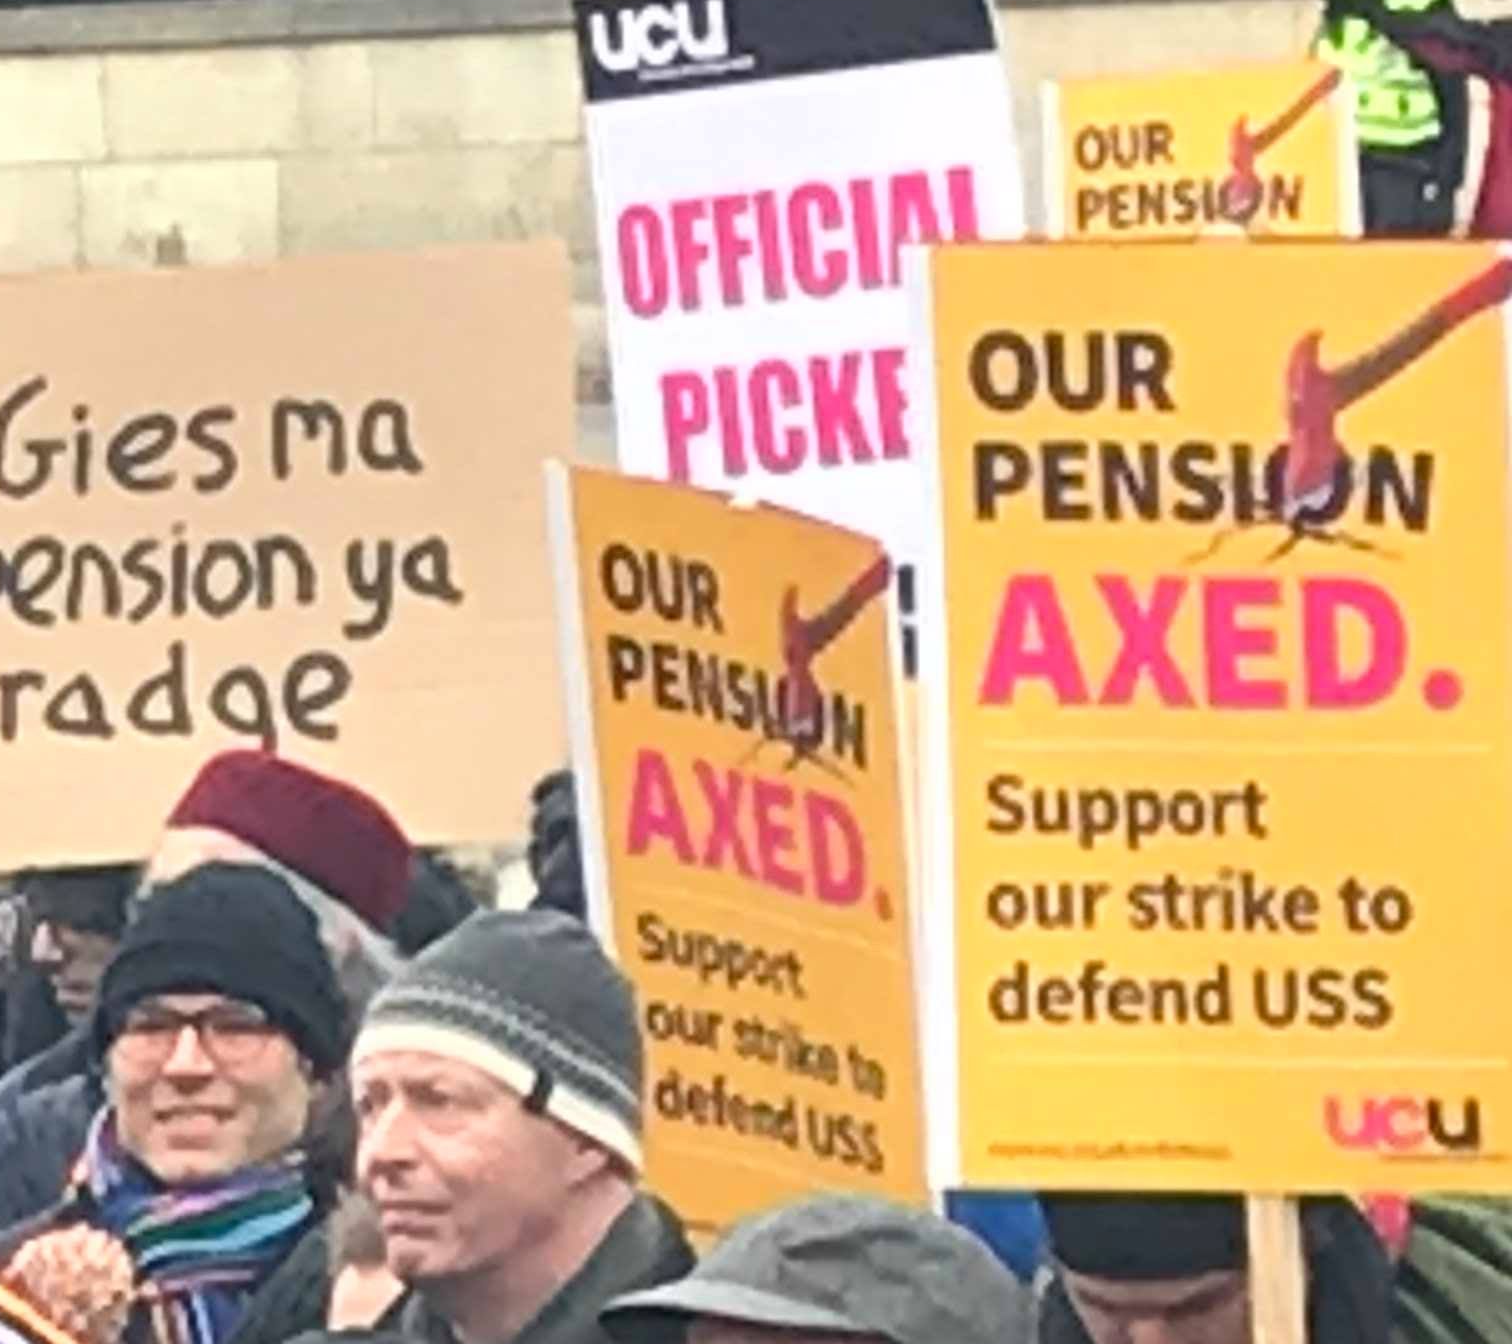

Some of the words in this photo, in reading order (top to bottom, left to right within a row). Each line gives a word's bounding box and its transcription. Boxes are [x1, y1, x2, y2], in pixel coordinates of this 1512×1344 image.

[1074, 120, 1175, 172] OUR
[1076, 174, 1304, 231] PENSION
[660, 348, 911, 485] PICKE
[969, 328, 1177, 414] OUR
[271, 396, 424, 480] ma
[972, 440, 1436, 533] PENSION
[343, 536, 465, 641] ya
[601, 542, 724, 636] OUR
[977, 572, 1464, 711] AXED.
[606, 634, 868, 772] PENSION
[626, 748, 894, 923] AXED.
[986, 772, 1269, 852] Support
[986, 881, 1110, 931] our
[1126, 866, 1320, 935] strike
[1338, 876, 1414, 935] to
[637, 910, 808, 1000] Support
[987, 959, 1232, 1027] defend
[1252, 966, 1395, 1030] USS
[646, 1001, 724, 1051] our
[733, 1015, 839, 1087] strike
[846, 1043, 887, 1101] to
[654, 1065, 800, 1150] defend
[806, 1104, 885, 1175] USS
